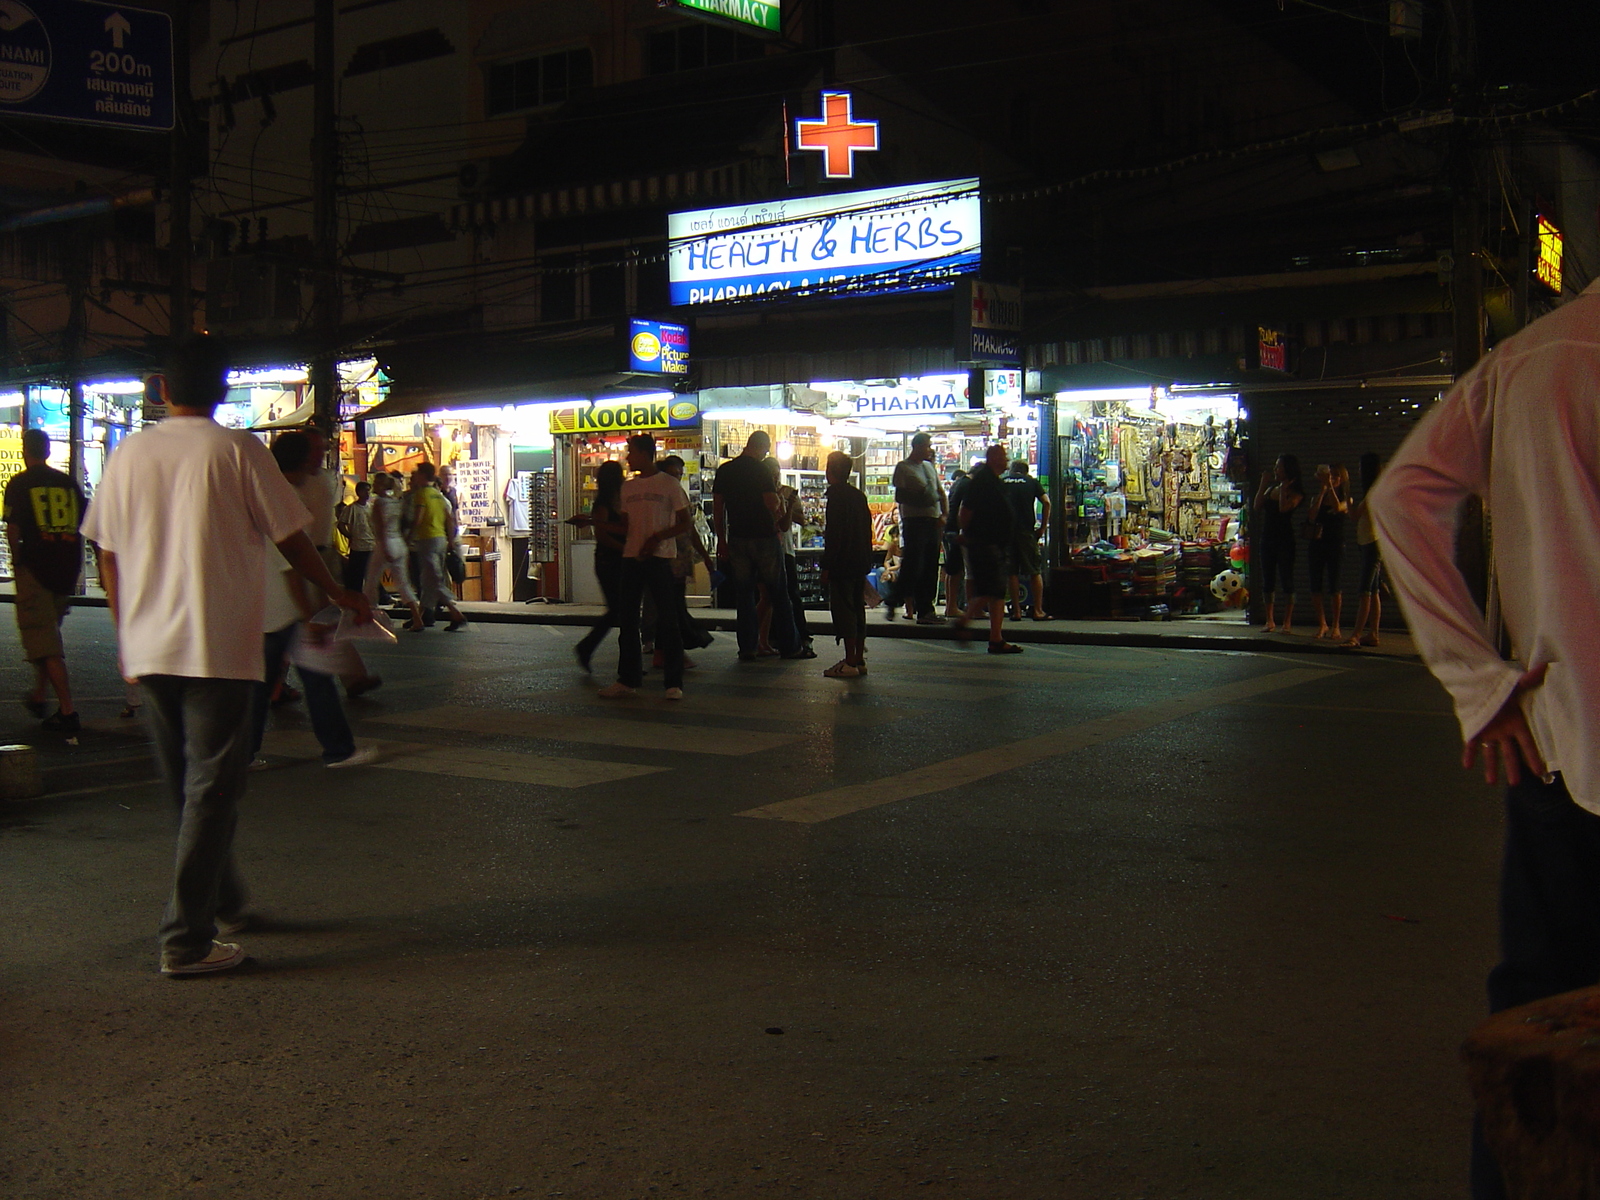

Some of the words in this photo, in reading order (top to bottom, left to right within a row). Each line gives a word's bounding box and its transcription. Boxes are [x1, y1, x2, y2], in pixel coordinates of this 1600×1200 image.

[90, 50, 152, 78] 200m
[688, 237, 798, 271] HEALTH
[811, 217, 838, 260] &
[850, 217, 963, 254] HERBS
[661, 330, 687, 345] Kodak
[661, 347, 690, 361] Picture
[661, 360, 688, 373] Maker
[578, 403, 667, 429] Kodak
[30, 487, 79, 534] FBI
